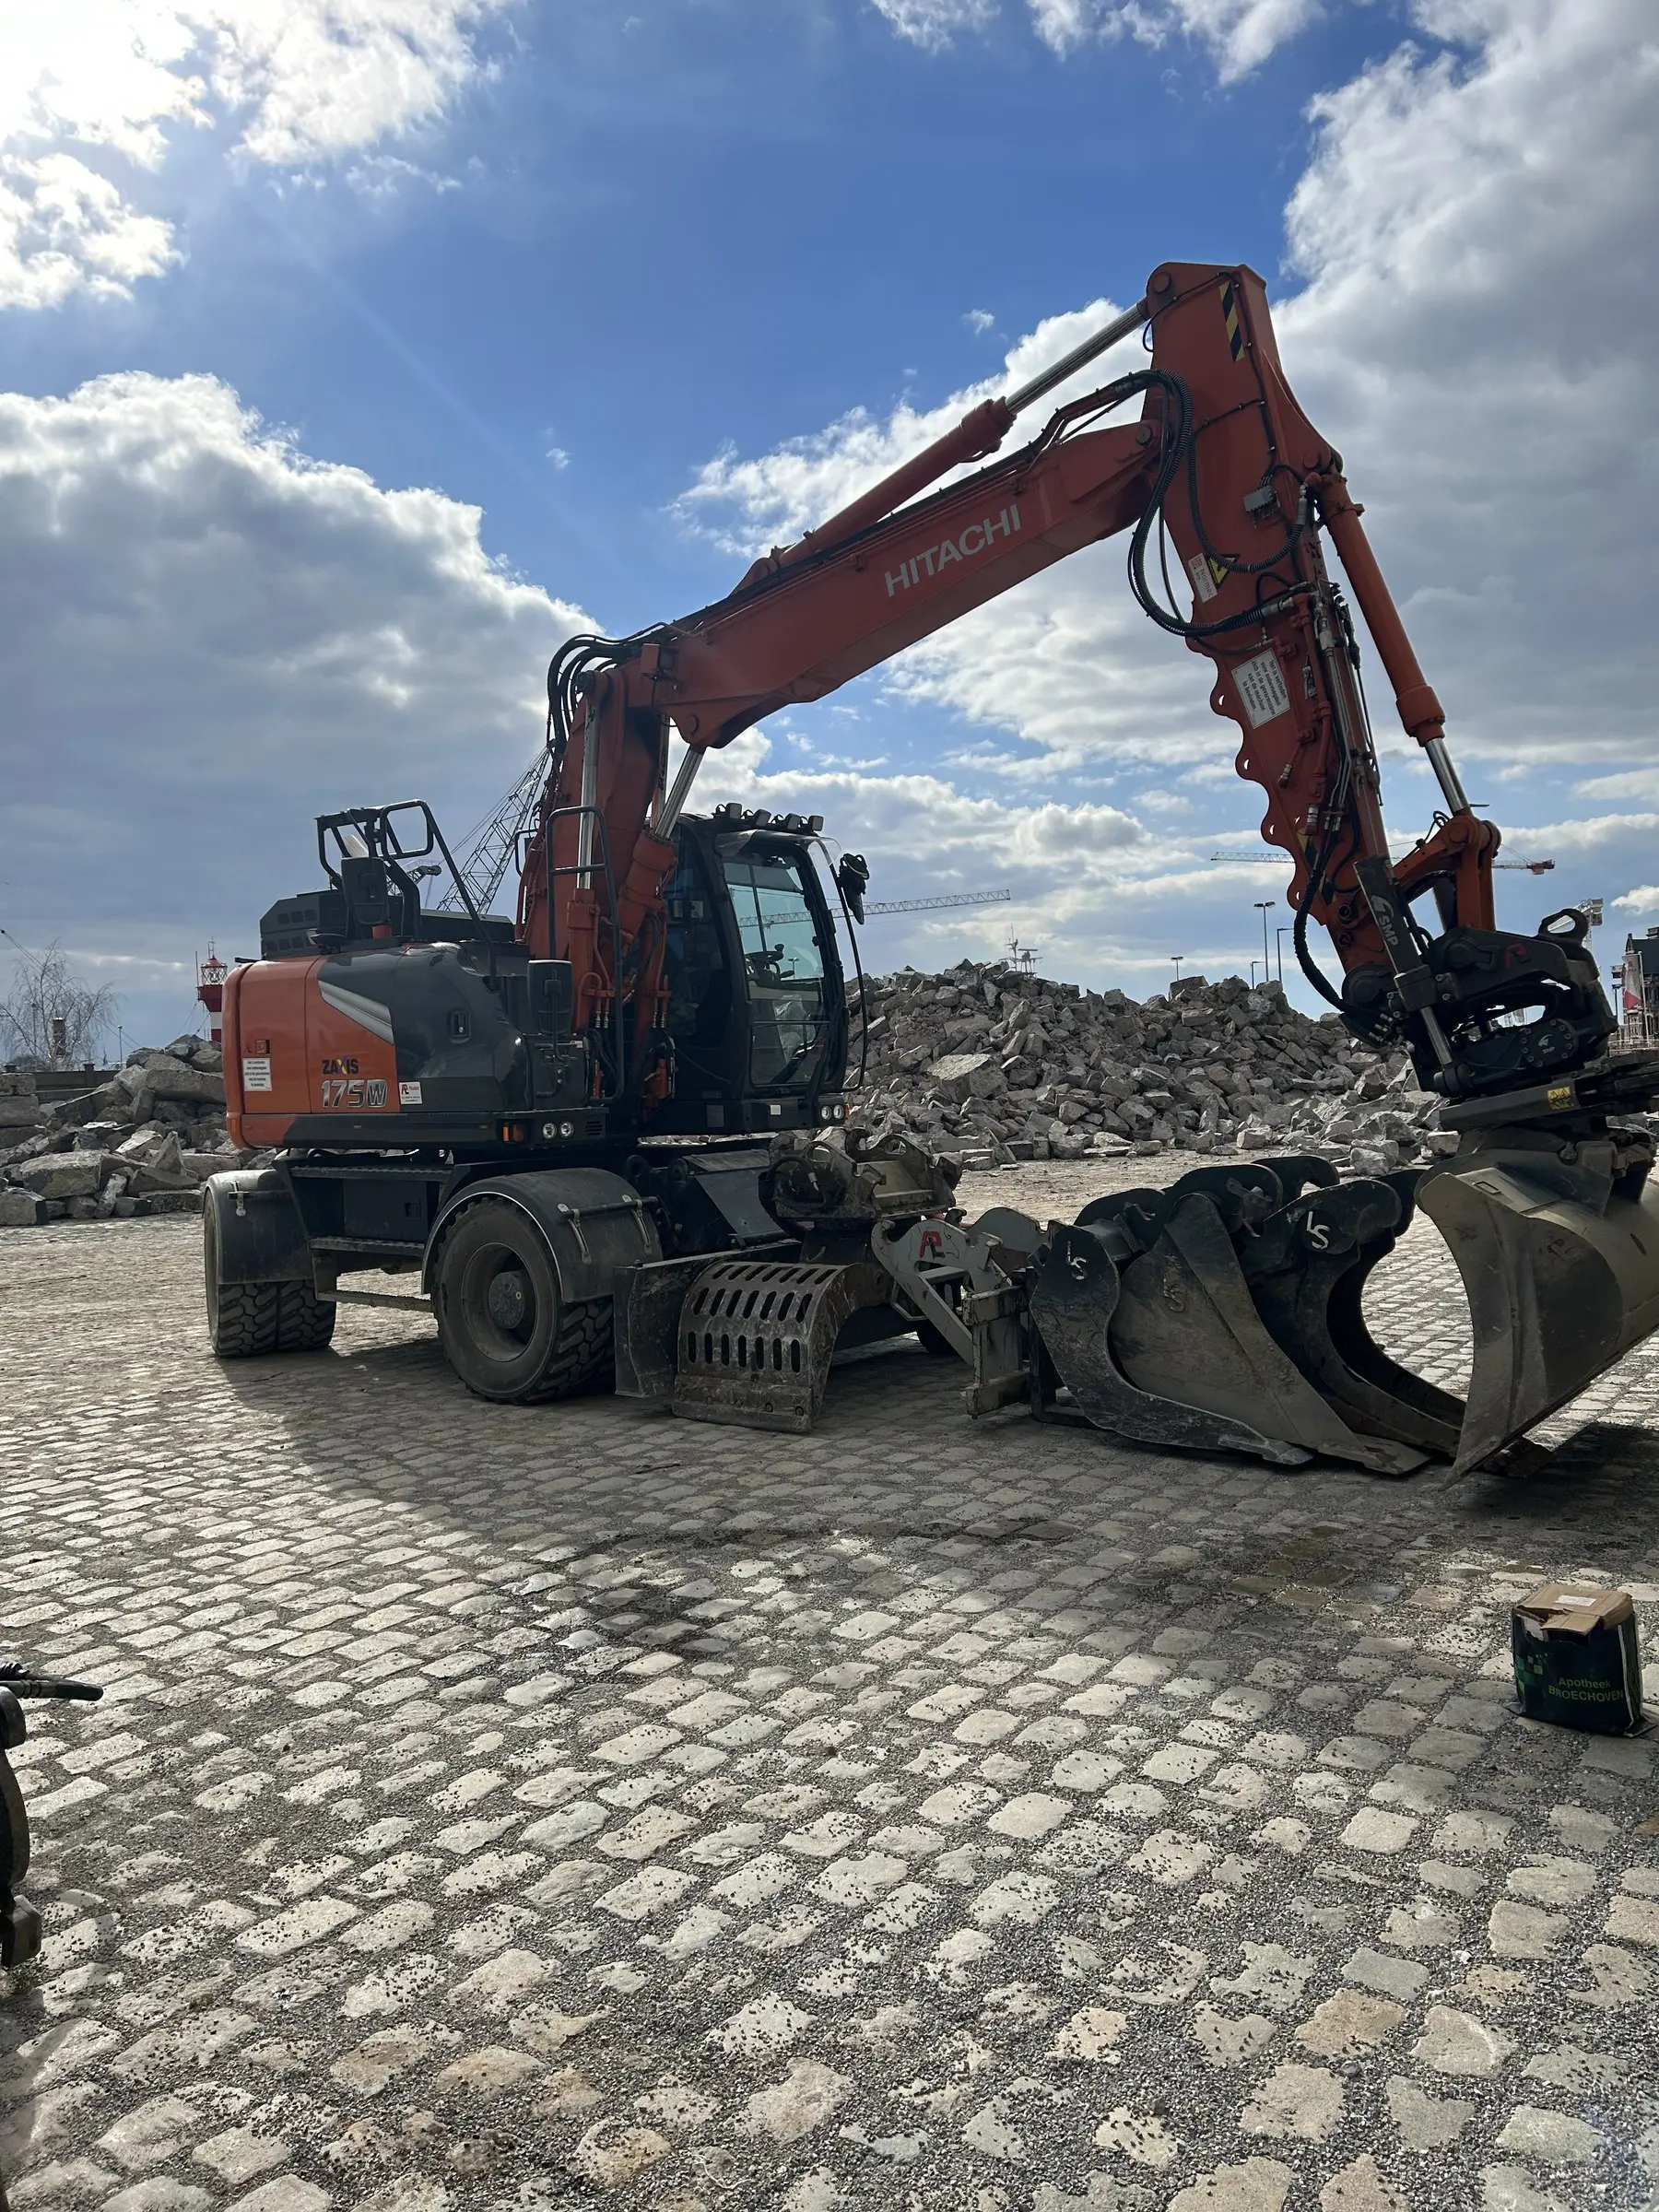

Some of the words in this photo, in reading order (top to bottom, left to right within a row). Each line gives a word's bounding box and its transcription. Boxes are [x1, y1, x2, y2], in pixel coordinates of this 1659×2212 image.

[884, 504, 1021, 597] HITACHI
[1377, 913, 1400, 947] SMP
[322, 1056, 359, 1076] ZAXIS
[321, 1078, 387, 1108] 175W
[1548, 1685, 1624, 1702] BROECHOVEN
[1559, 1677, 1611, 1689] Apotheek
